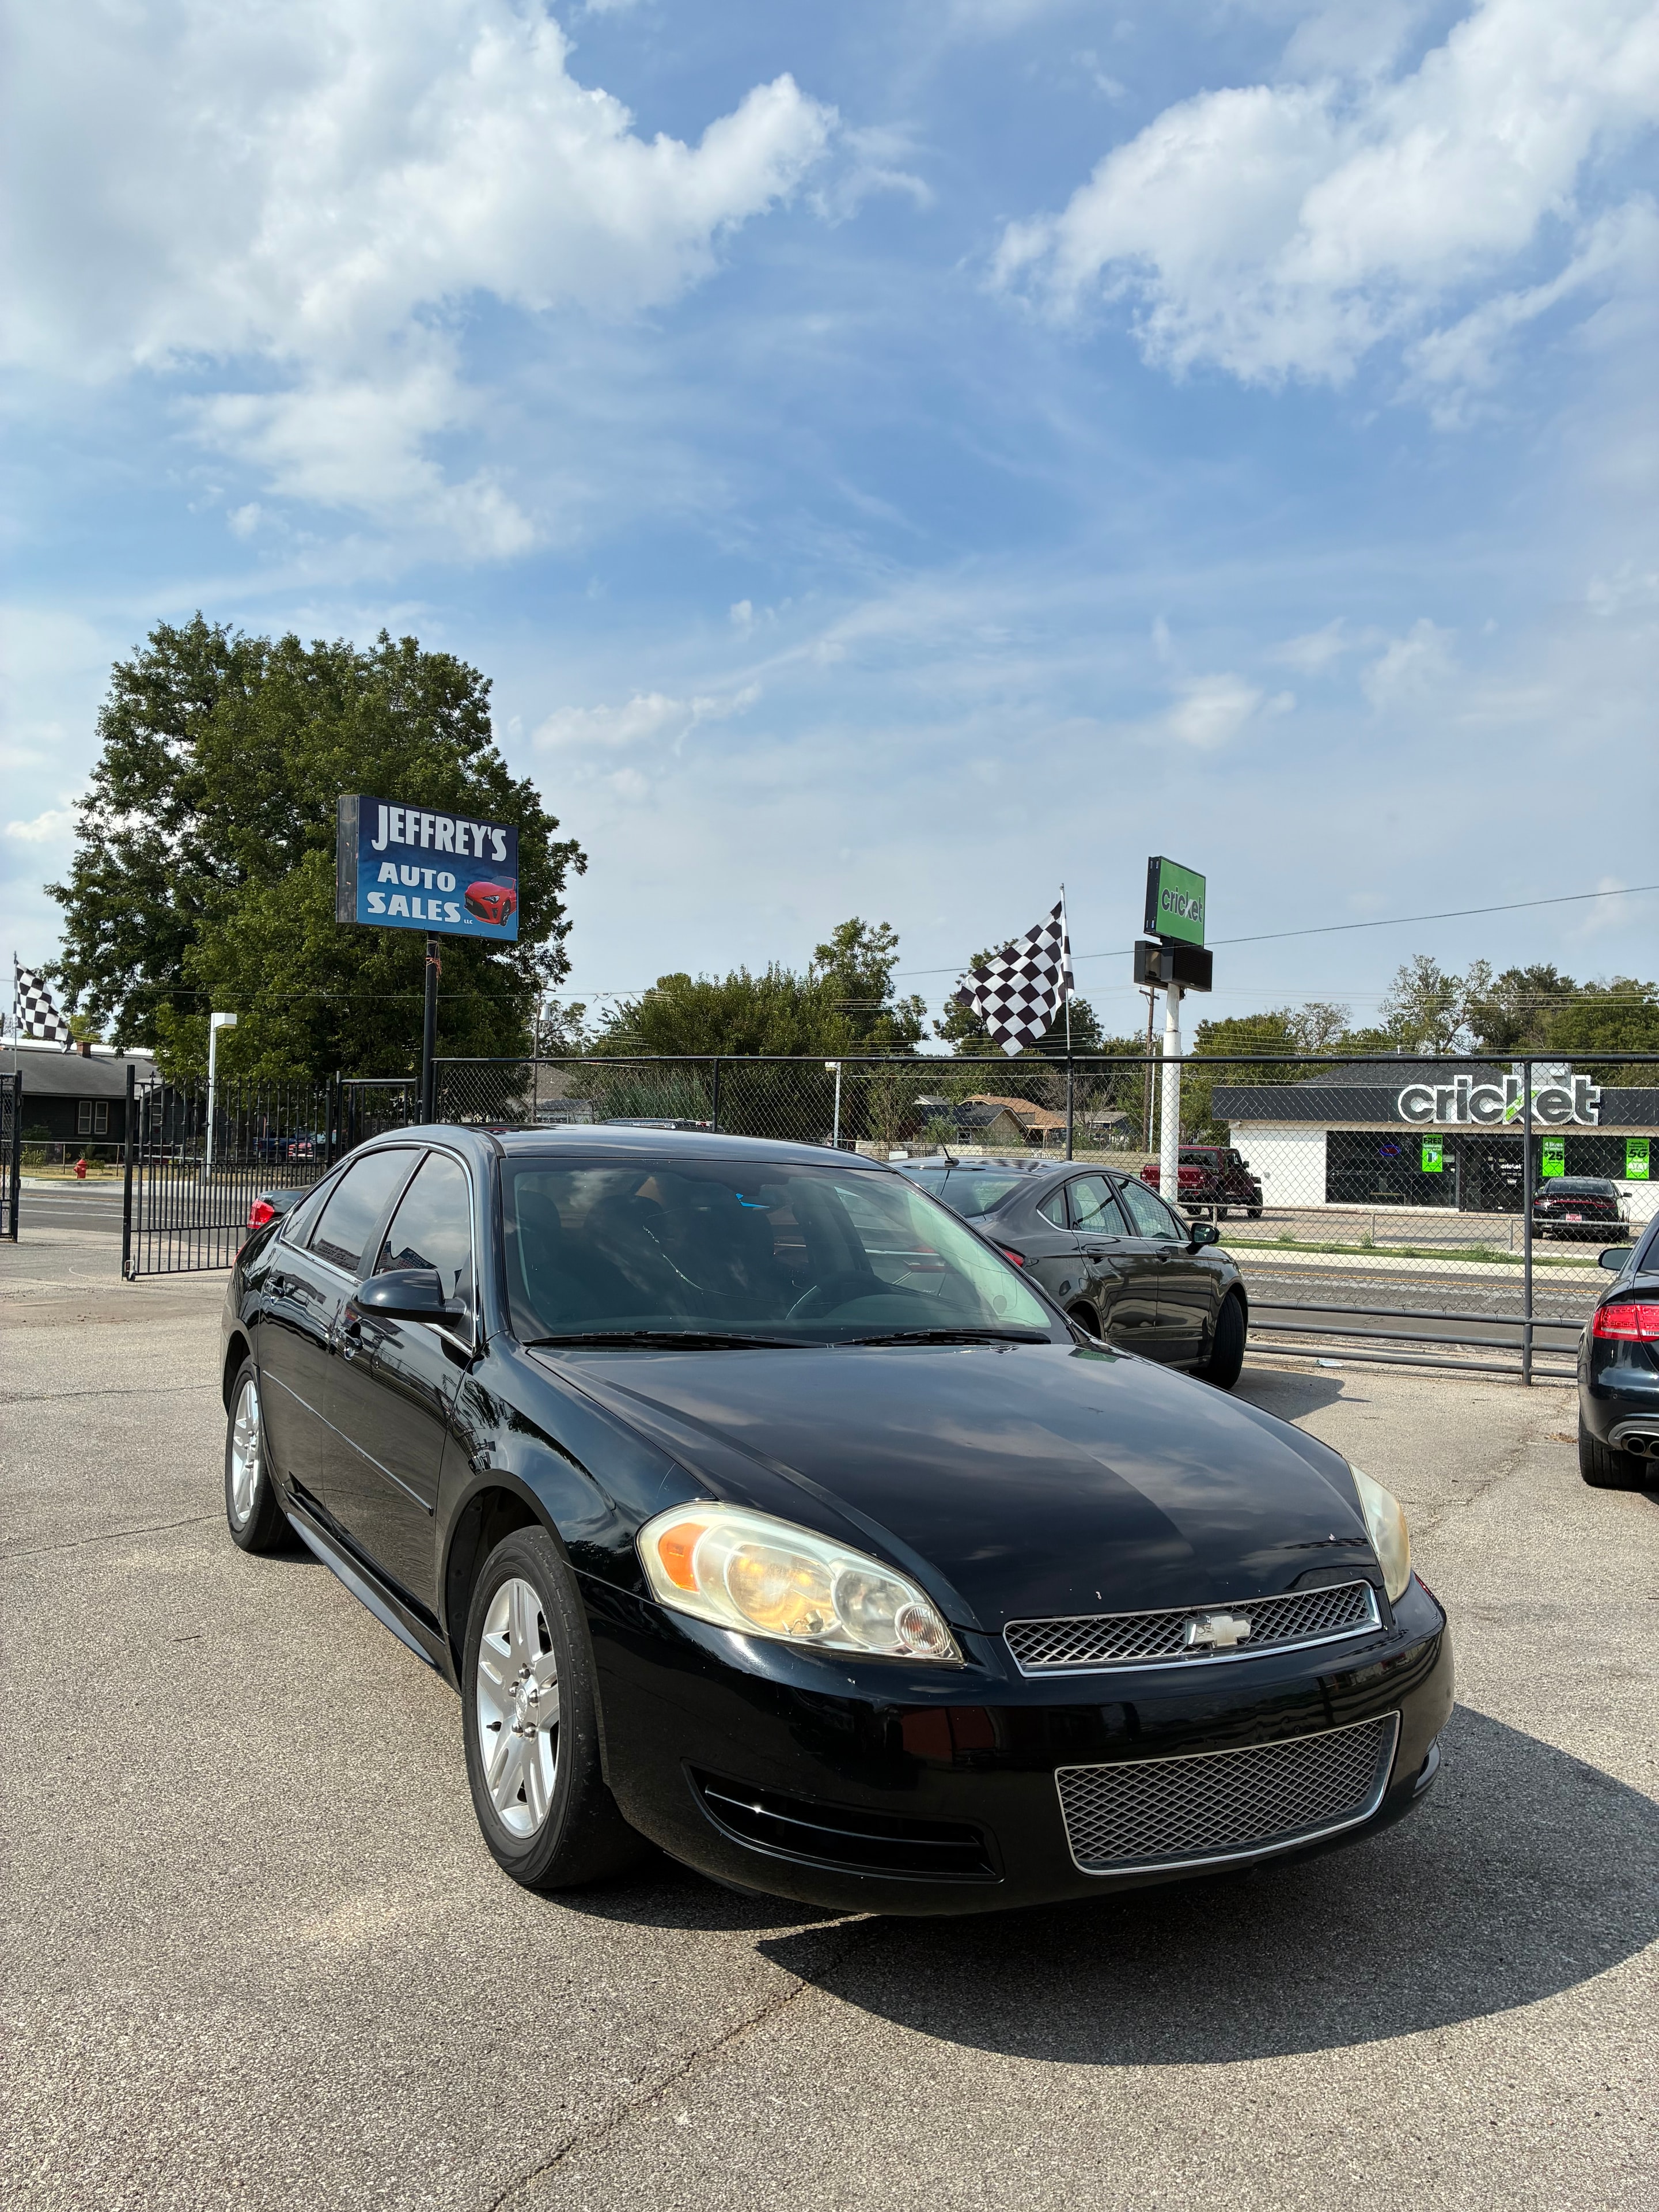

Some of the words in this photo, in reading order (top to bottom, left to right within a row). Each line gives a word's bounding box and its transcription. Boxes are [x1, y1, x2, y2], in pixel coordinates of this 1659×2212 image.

[371, 804, 507, 862] JEFFREY'S
[377, 862, 456, 892] AUTO
[367, 892, 461, 923] SALES
[1161, 885, 1203, 924] cricket
[1398, 1075, 1600, 1126] cricket
[1544, 1150, 1563, 1161] $25
[1628, 1149, 1648, 1158] 5G
